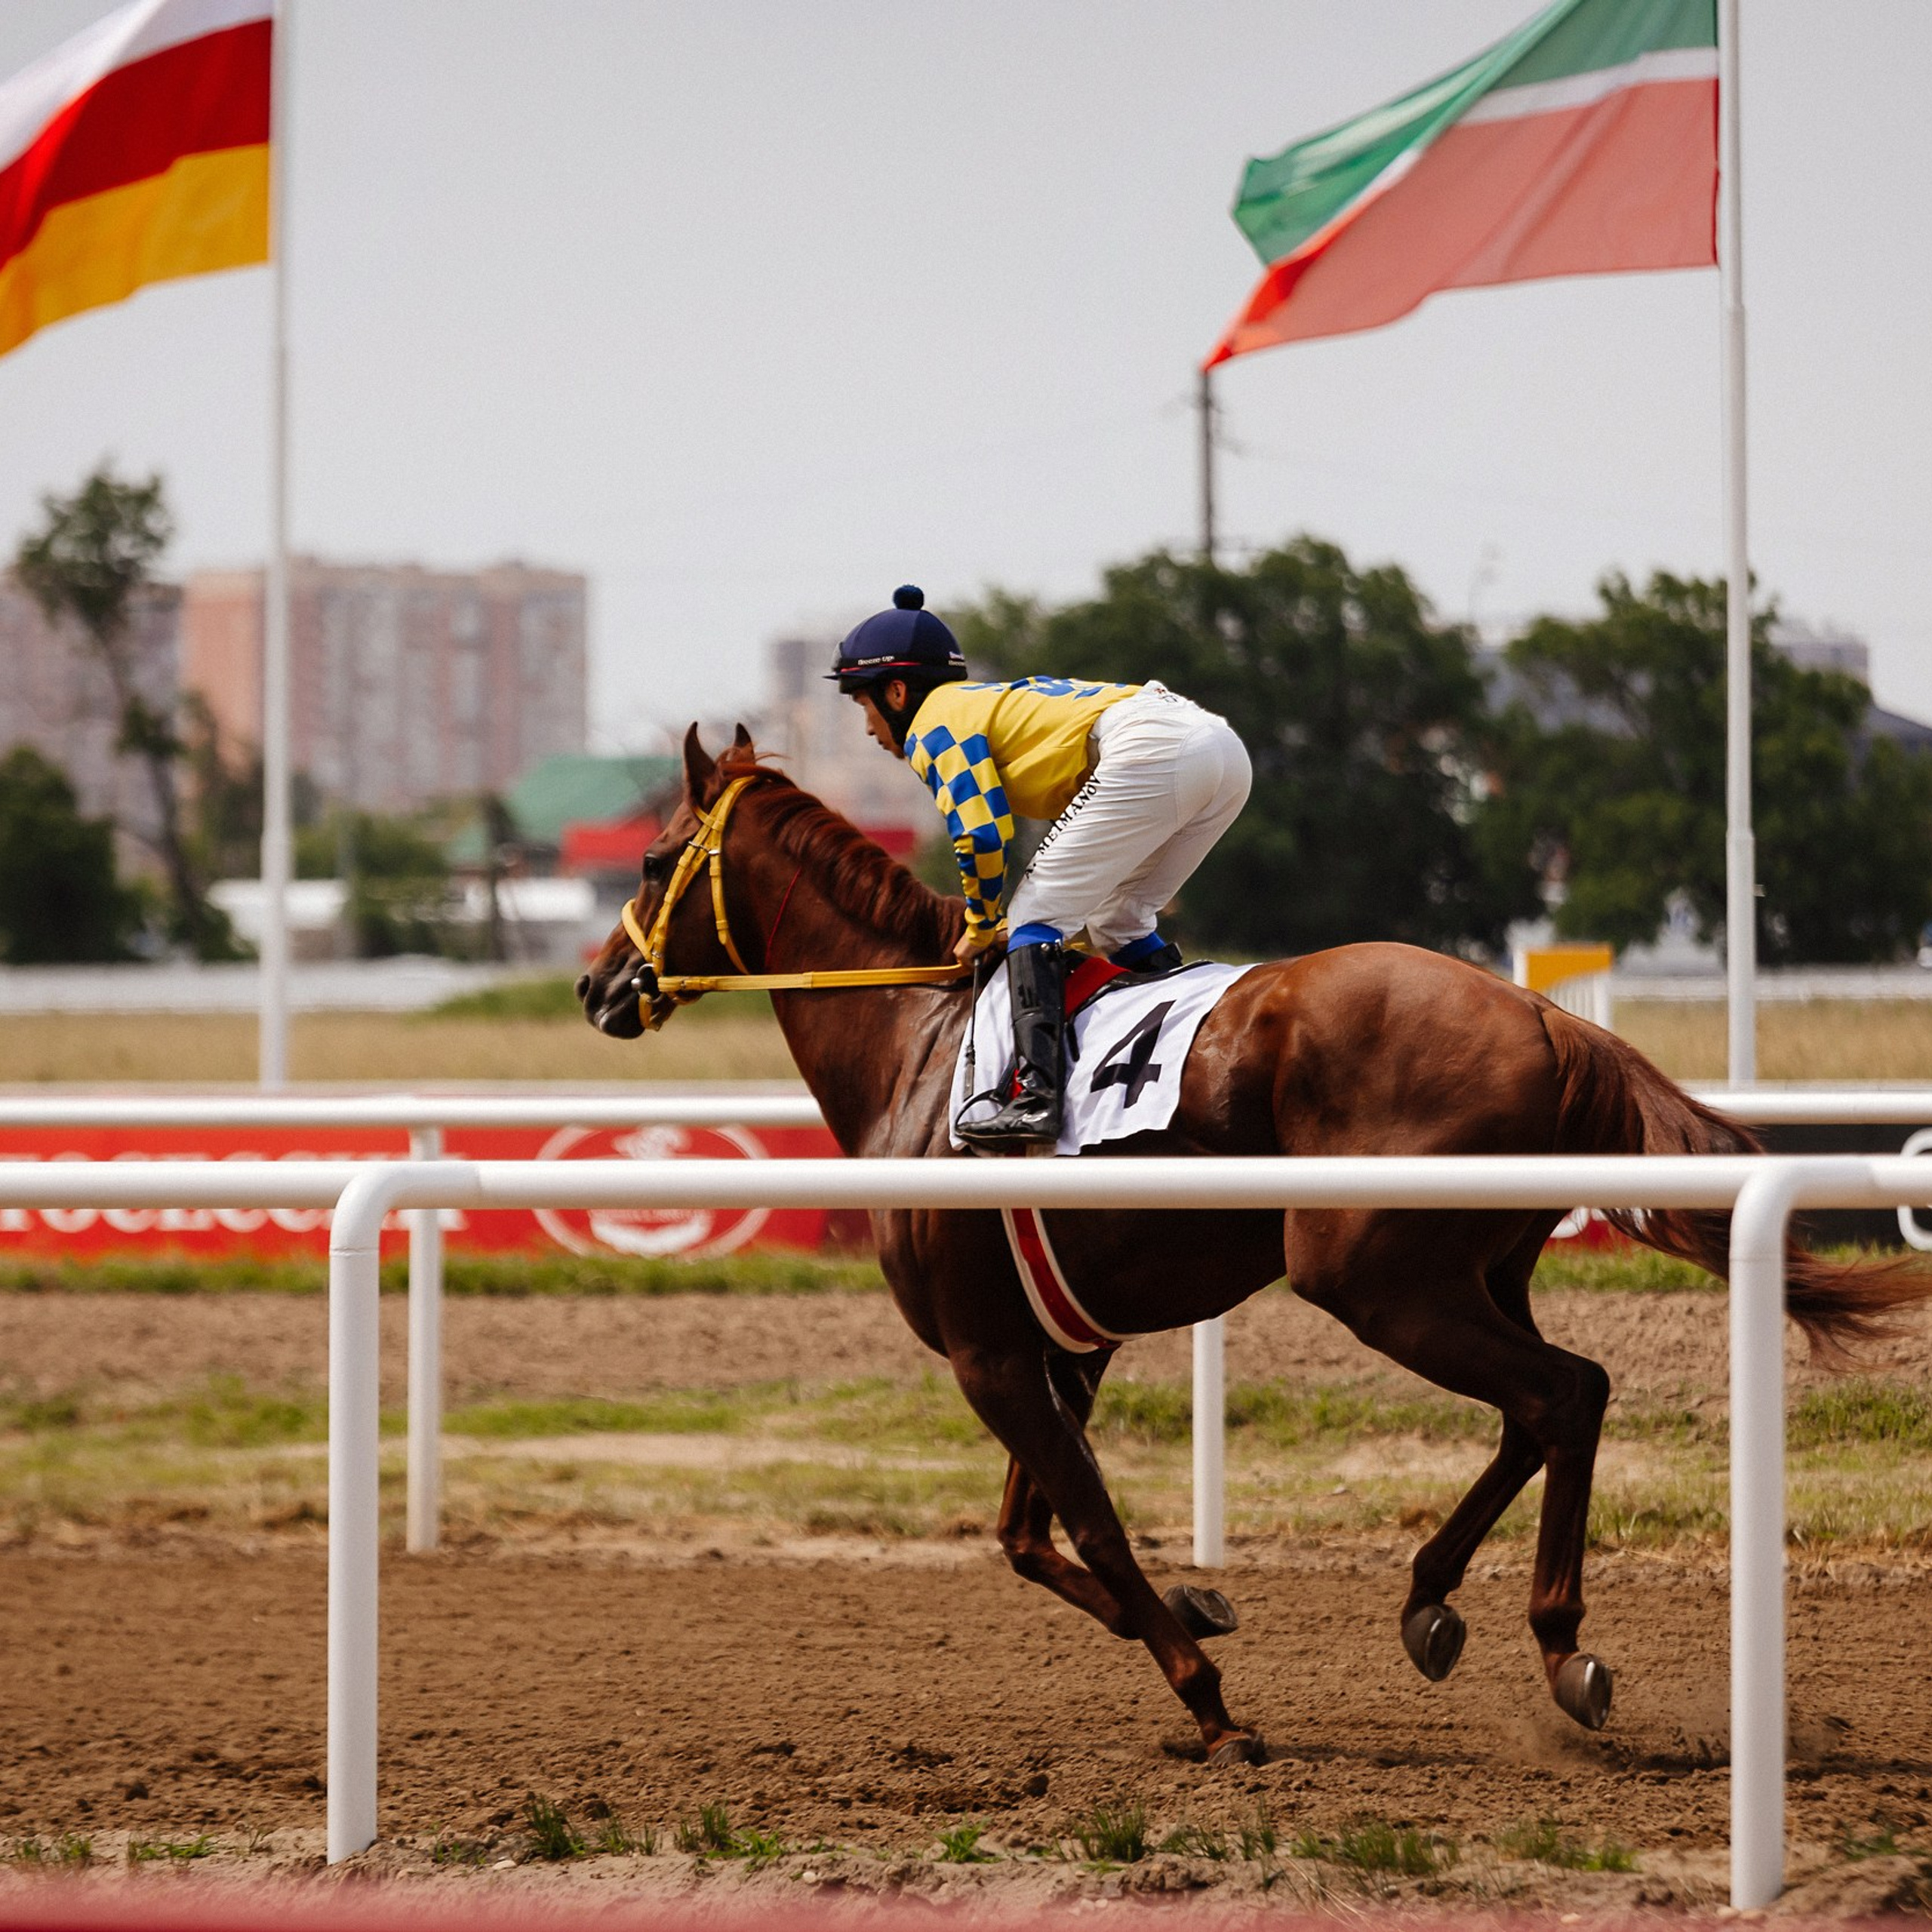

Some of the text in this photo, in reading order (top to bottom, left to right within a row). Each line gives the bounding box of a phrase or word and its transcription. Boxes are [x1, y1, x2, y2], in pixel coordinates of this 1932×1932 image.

[1025, 775, 1101, 879] A. MEIMANOV
[1091, 999, 1177, 1109] 4
